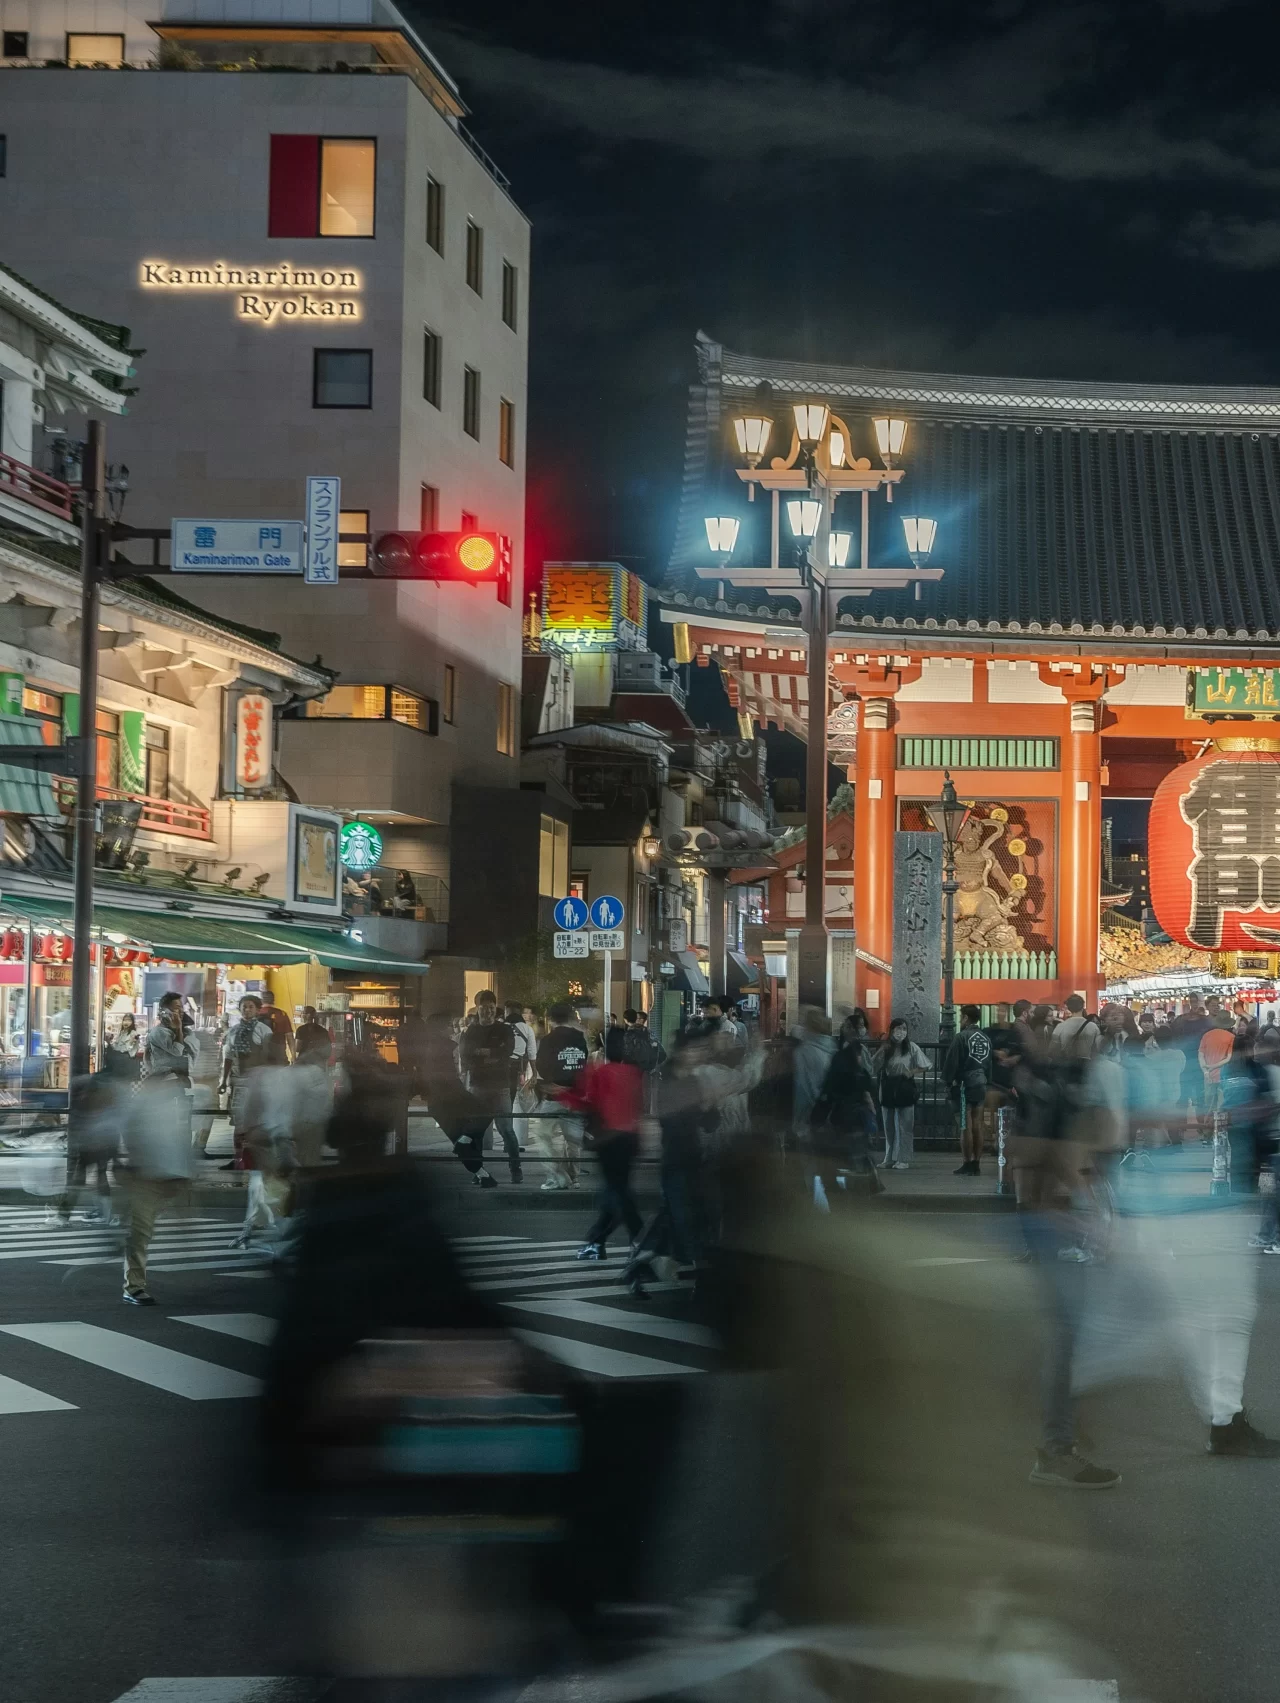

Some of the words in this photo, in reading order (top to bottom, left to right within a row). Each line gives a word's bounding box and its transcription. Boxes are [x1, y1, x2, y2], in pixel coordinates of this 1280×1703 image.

[142, 263, 358, 287] Kaminarimon
[239, 295, 358, 321] Ryokan
[194, 526, 282, 549] 雷門
[312, 481, 332, 580] スクランブル式
[183, 552, 260, 567] Kaminarimon
[263, 553, 291, 567] Gate
